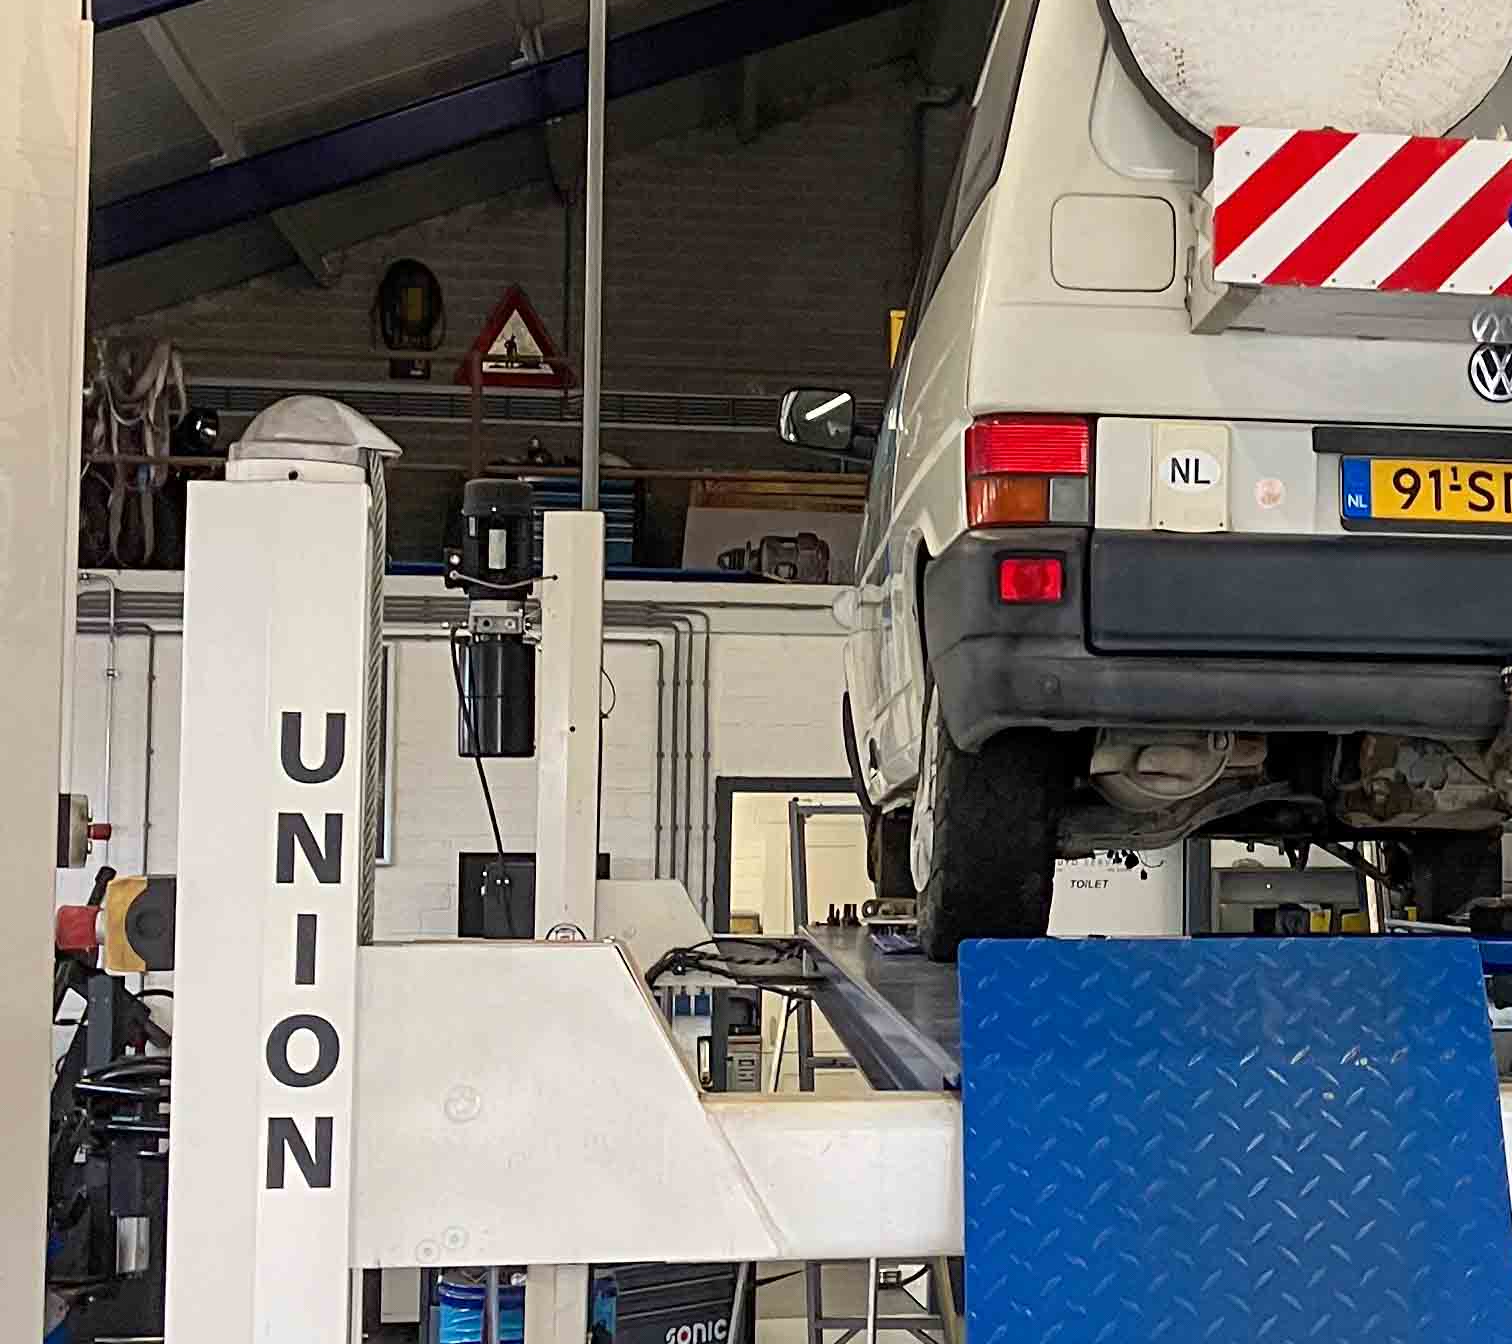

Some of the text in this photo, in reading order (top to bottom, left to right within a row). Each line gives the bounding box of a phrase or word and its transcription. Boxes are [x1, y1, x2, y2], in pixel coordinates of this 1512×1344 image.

[1170, 457, 1211, 485] NL
[1347, 493, 1367, 509] NL
[1070, 879, 1109, 889] TOILET
[265, 711, 346, 1190] UNION
